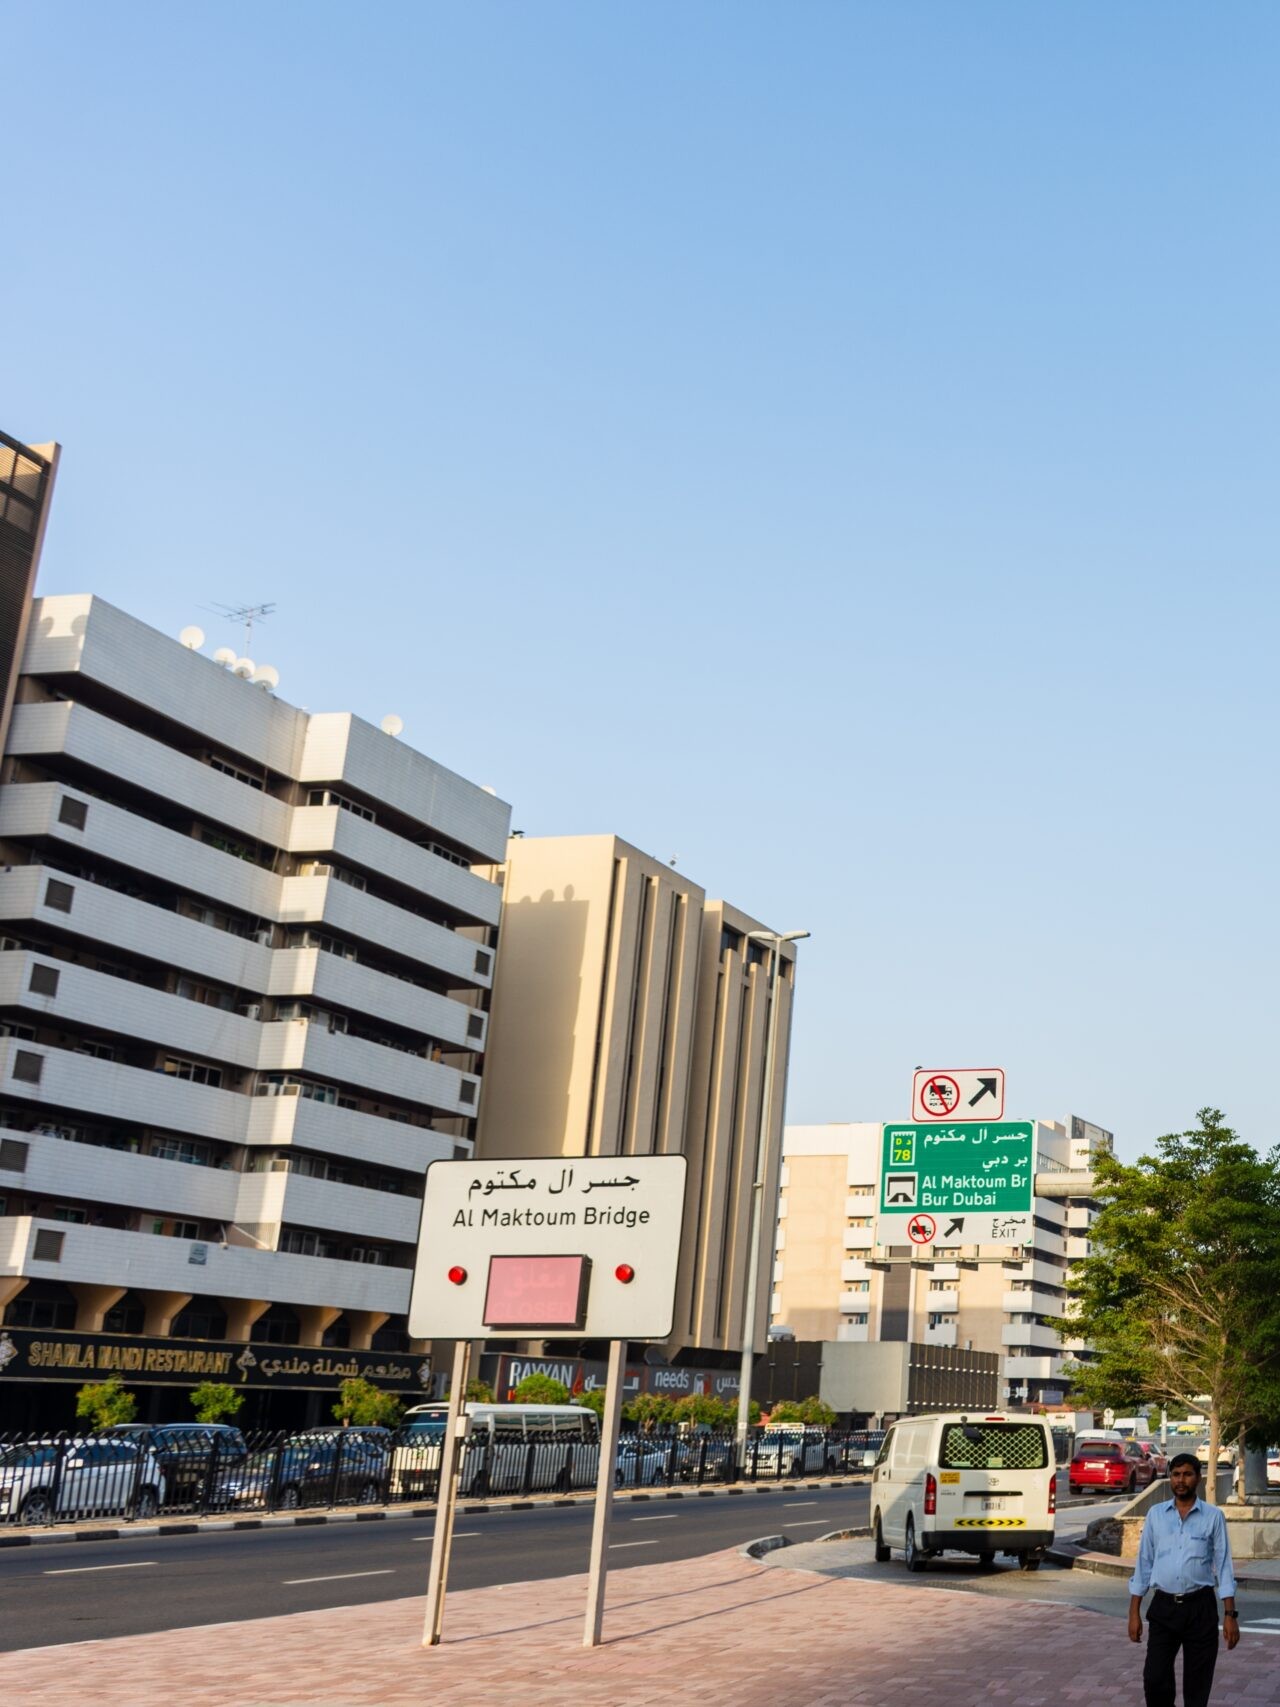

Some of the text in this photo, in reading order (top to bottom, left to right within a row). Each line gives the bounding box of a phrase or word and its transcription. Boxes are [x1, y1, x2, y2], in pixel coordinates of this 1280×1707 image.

[923, 1129, 967, 1149] مكتوم
[991, 1132, 1029, 1144] جسر
[894, 1150, 911, 1161] 78
[982, 1155, 1029, 1173] بر دبي
[468, 1169, 537, 1201] مكتوم
[581, 1175, 641, 1194] جسر
[921, 1173, 1028, 1189] Al Maktoum Br
[921, 1191, 997, 1207] Bur Dubai
[452, 1206, 650, 1228] Al Maktoum Bridge
[991, 1228, 1018, 1239] EXIT
[146, 1348, 232, 1374] RESTAURANT
[654, 1368, 690, 1390] needs
